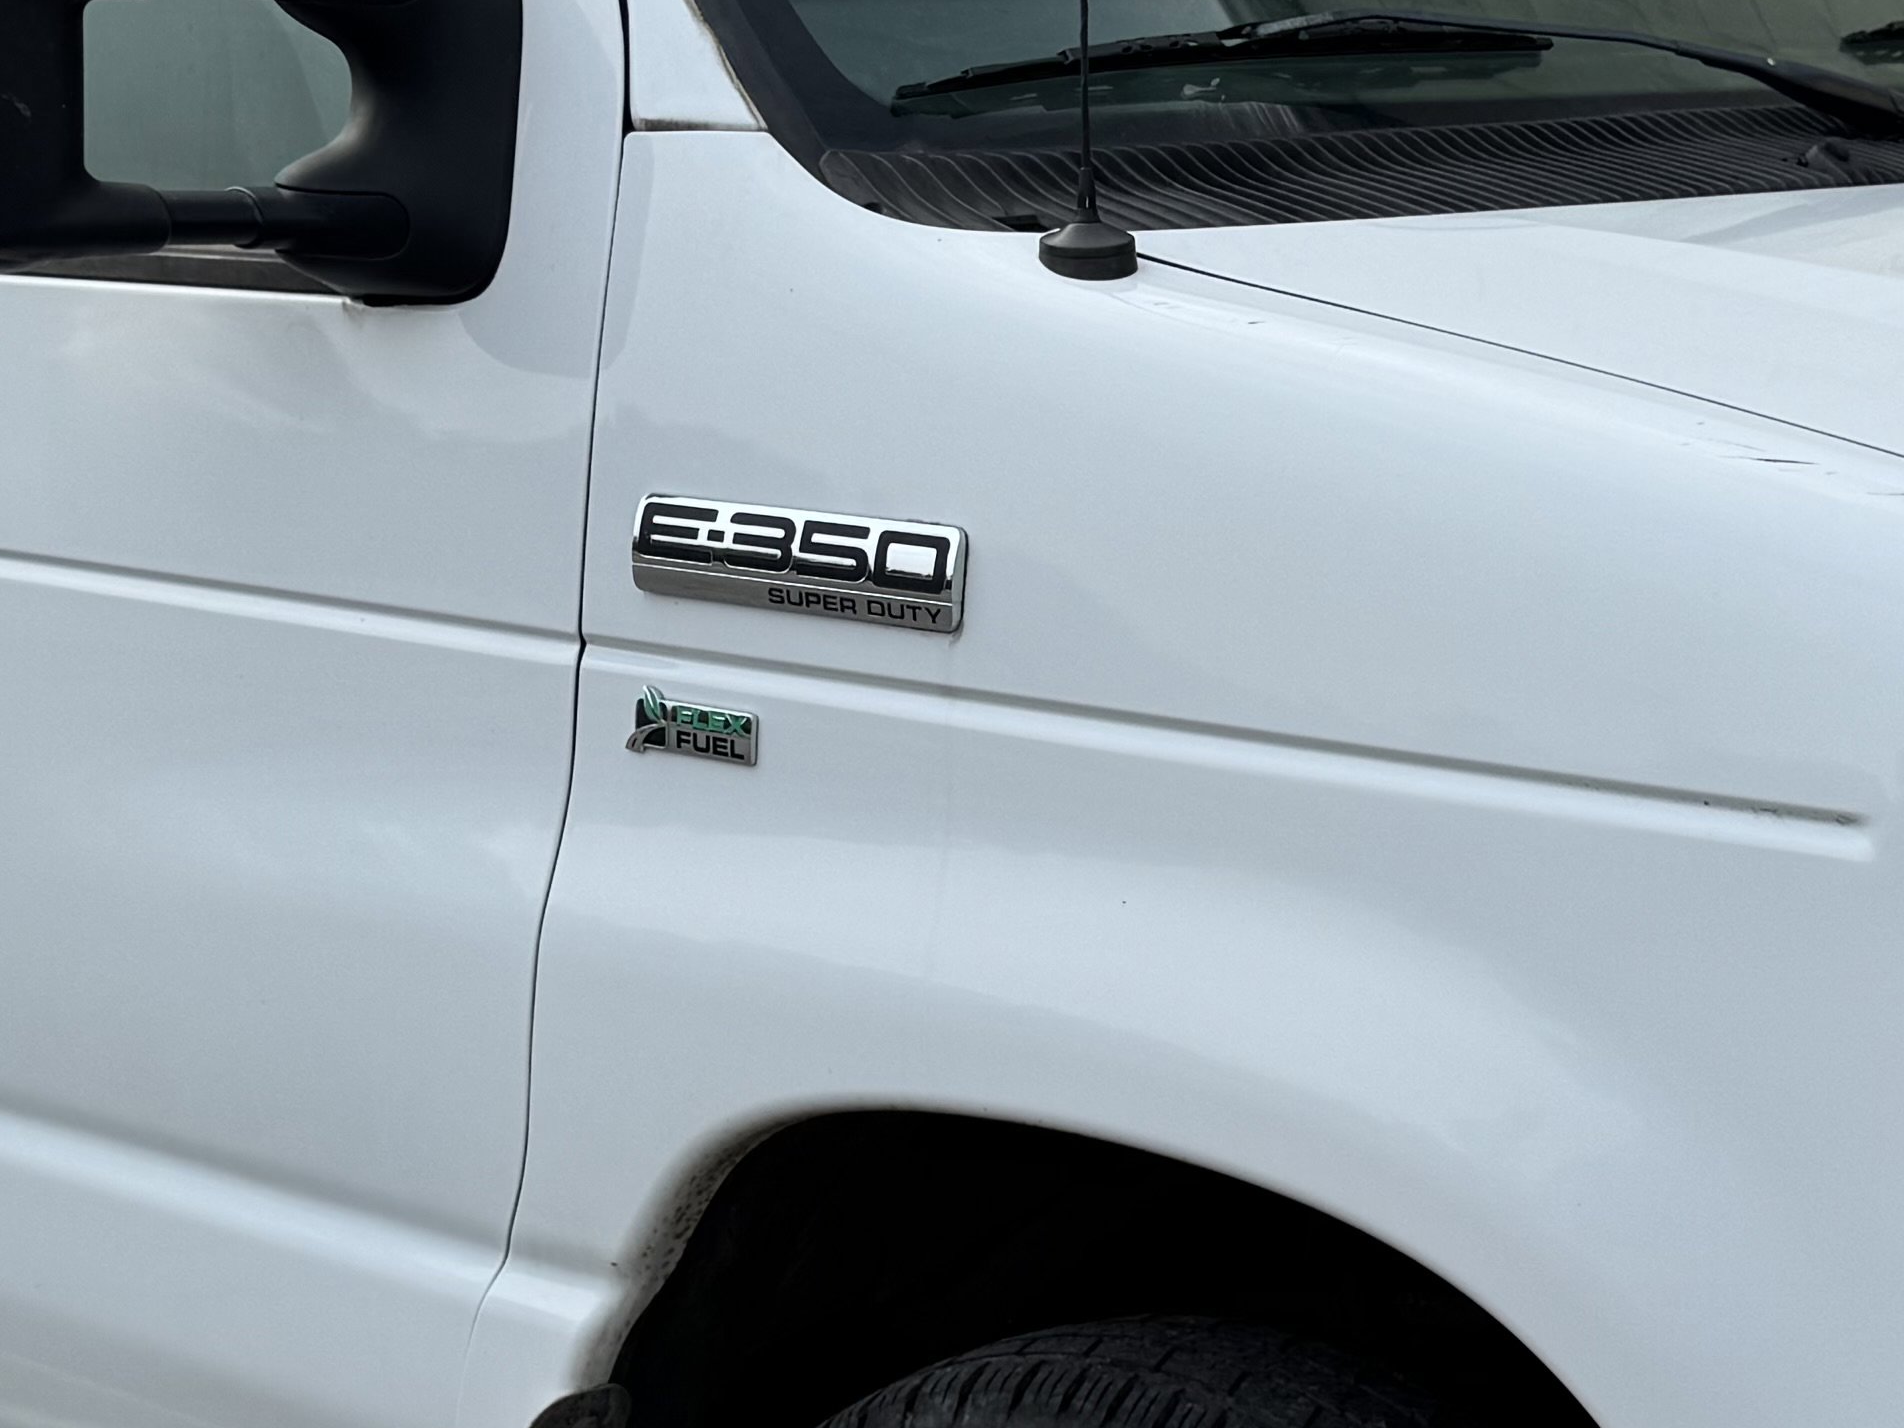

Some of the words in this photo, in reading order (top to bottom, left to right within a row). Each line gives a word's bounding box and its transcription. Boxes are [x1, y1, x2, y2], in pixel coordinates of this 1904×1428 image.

[637, 501, 952, 594] E-350
[768, 587, 857, 615] SUPER
[866, 599, 942, 624] DUTY
[676, 705, 752, 740] FLEX
[676, 729, 745, 760] FUEL
